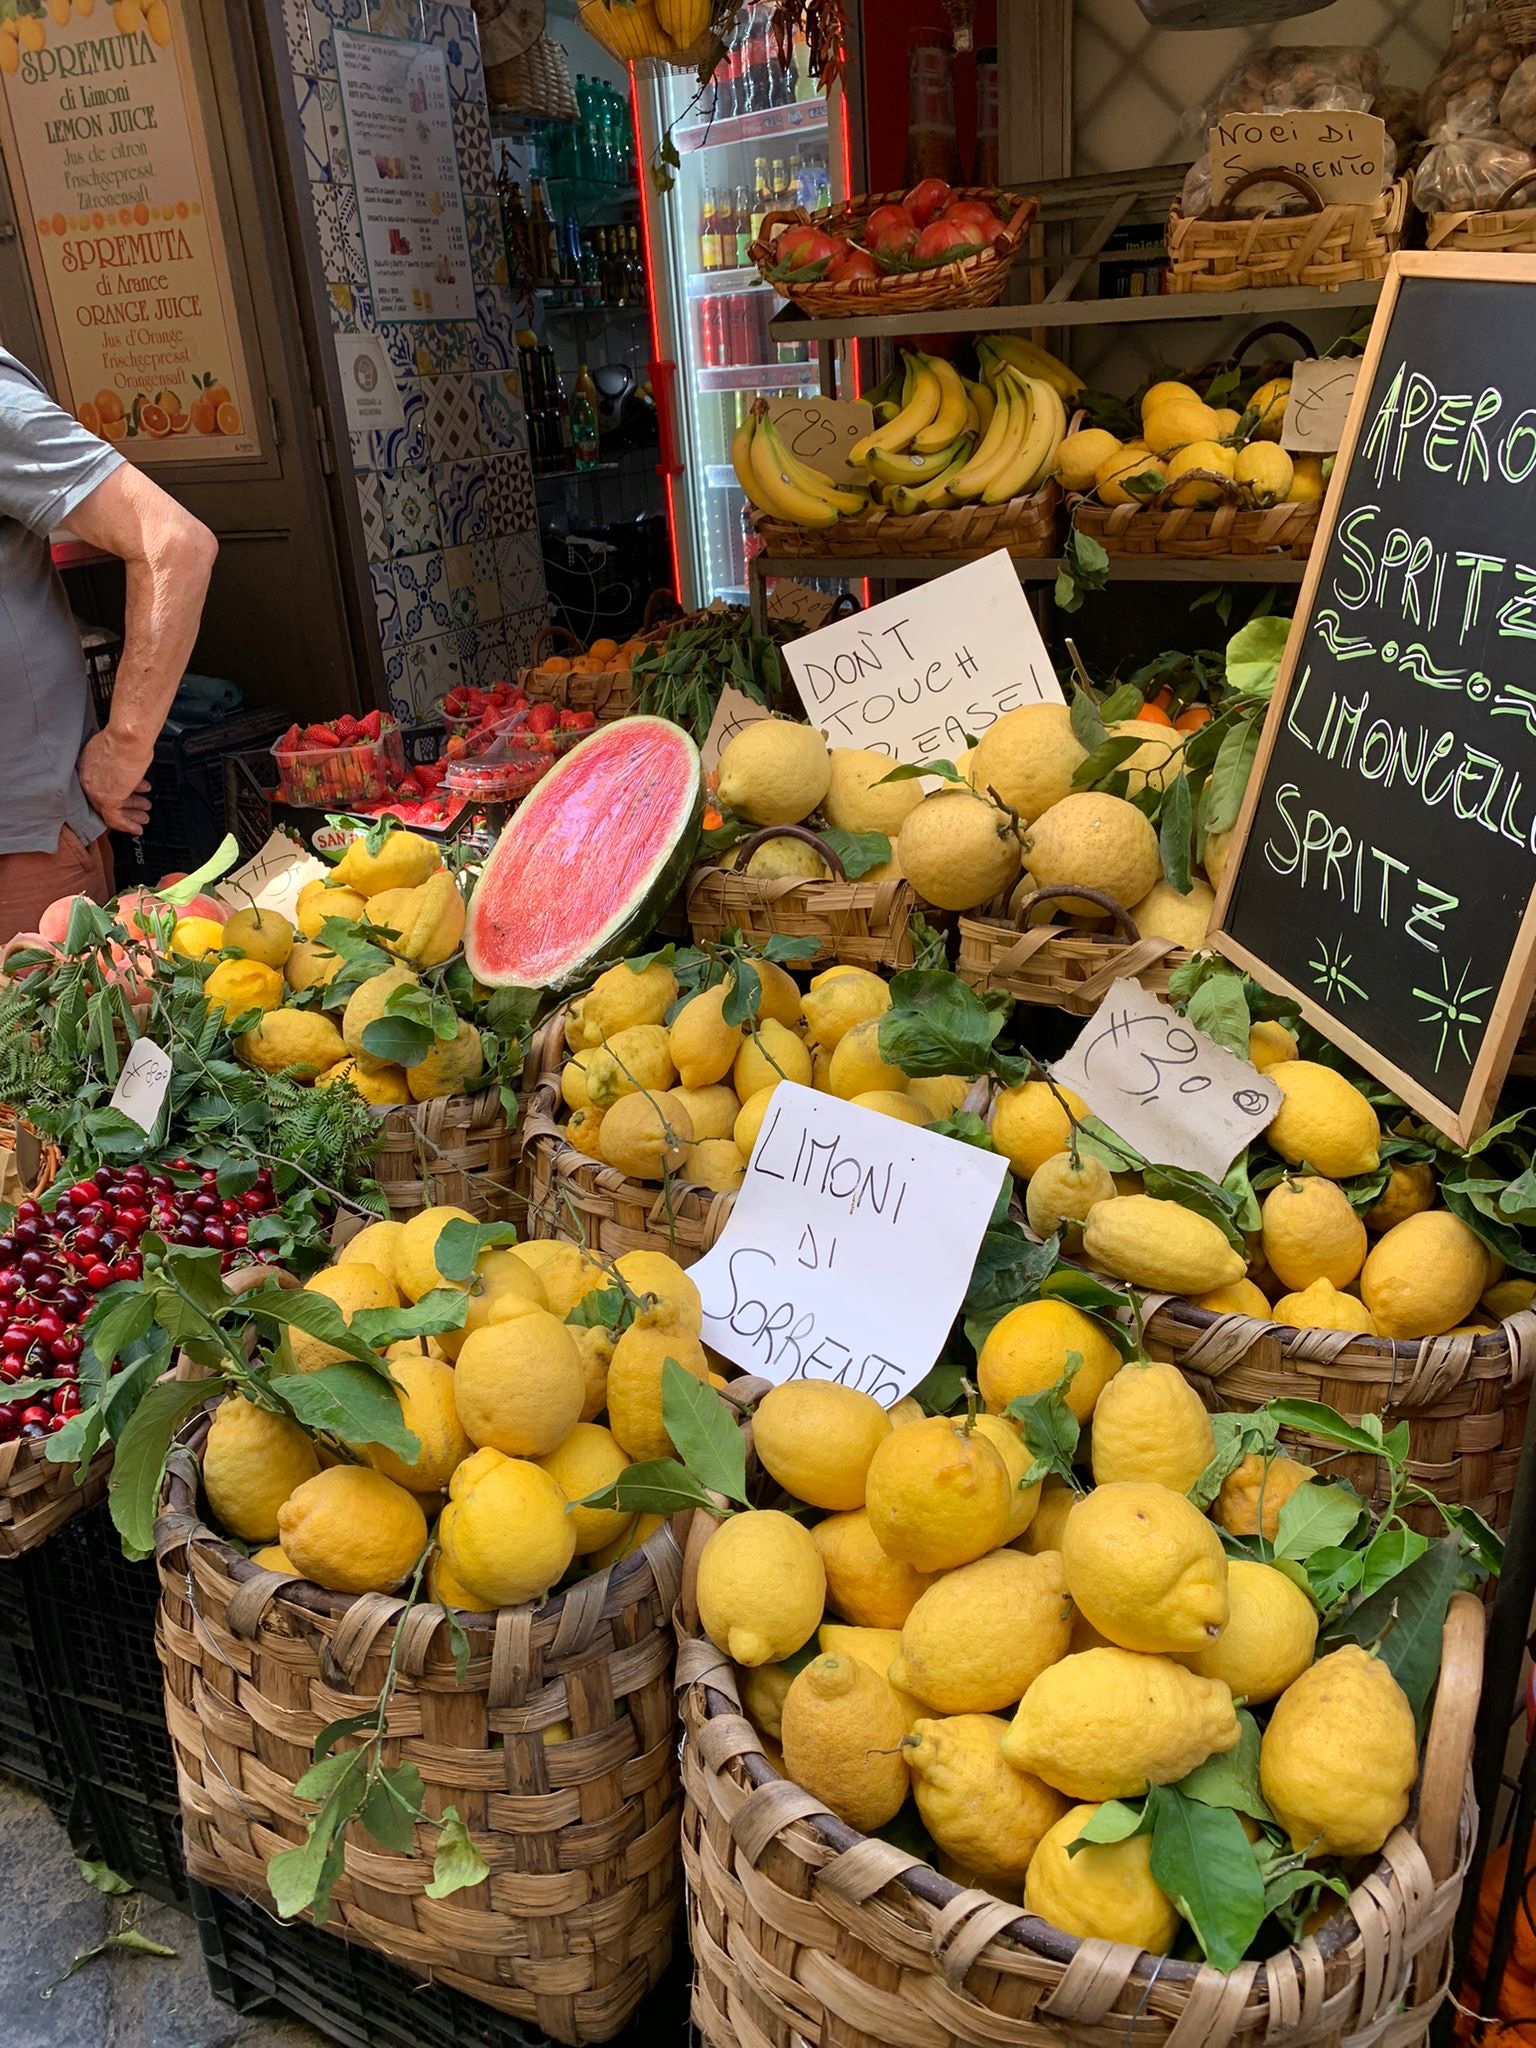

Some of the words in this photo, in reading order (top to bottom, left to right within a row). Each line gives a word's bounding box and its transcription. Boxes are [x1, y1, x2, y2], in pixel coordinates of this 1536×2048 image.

[21, 30, 157, 85] SPREMUTA
[60, 87, 77, 110] di
[79, 80, 131, 108] Limoni
[44, 114, 103, 144] LEMON
[109, 105, 158, 135] JUICE
[62, 228, 194, 272] SPREMUTA
[96, 273, 112, 296] di
[118, 274, 169, 294] Arance
[76, 300, 150, 327] ORANGE
[154, 294, 203, 320] JUICE
[101, 331, 122, 348] Jus
[1362, 361, 1536, 490] APERO
[1333, 504, 1536, 646] SPRITZ
[821, 646, 978, 735] TOUCH
[1287, 665, 1536, 856] LIMONCELL
[317, 832, 346, 849] SAN
[1264, 783, 1460, 954] SPRITZ
